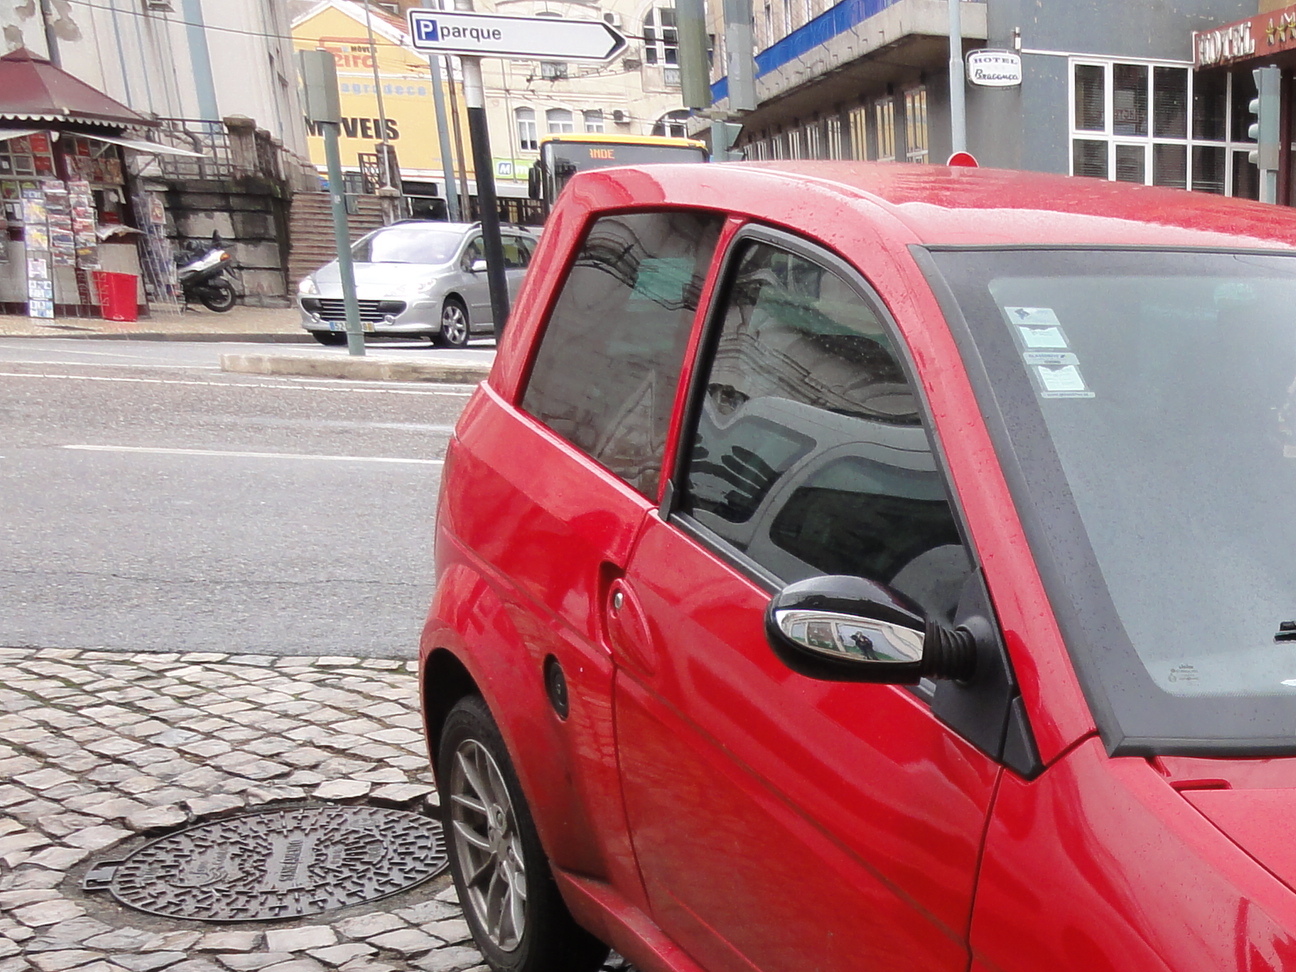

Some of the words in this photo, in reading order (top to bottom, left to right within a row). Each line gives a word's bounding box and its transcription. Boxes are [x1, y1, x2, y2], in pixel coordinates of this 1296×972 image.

[419, 22, 433, 40] P
[440, 25, 502, 43] parque
[1198, 21, 1256, 66] HOTEL
[973, 57, 1018, 65] HOTEL
[304, 117, 399, 140] MVEIS
